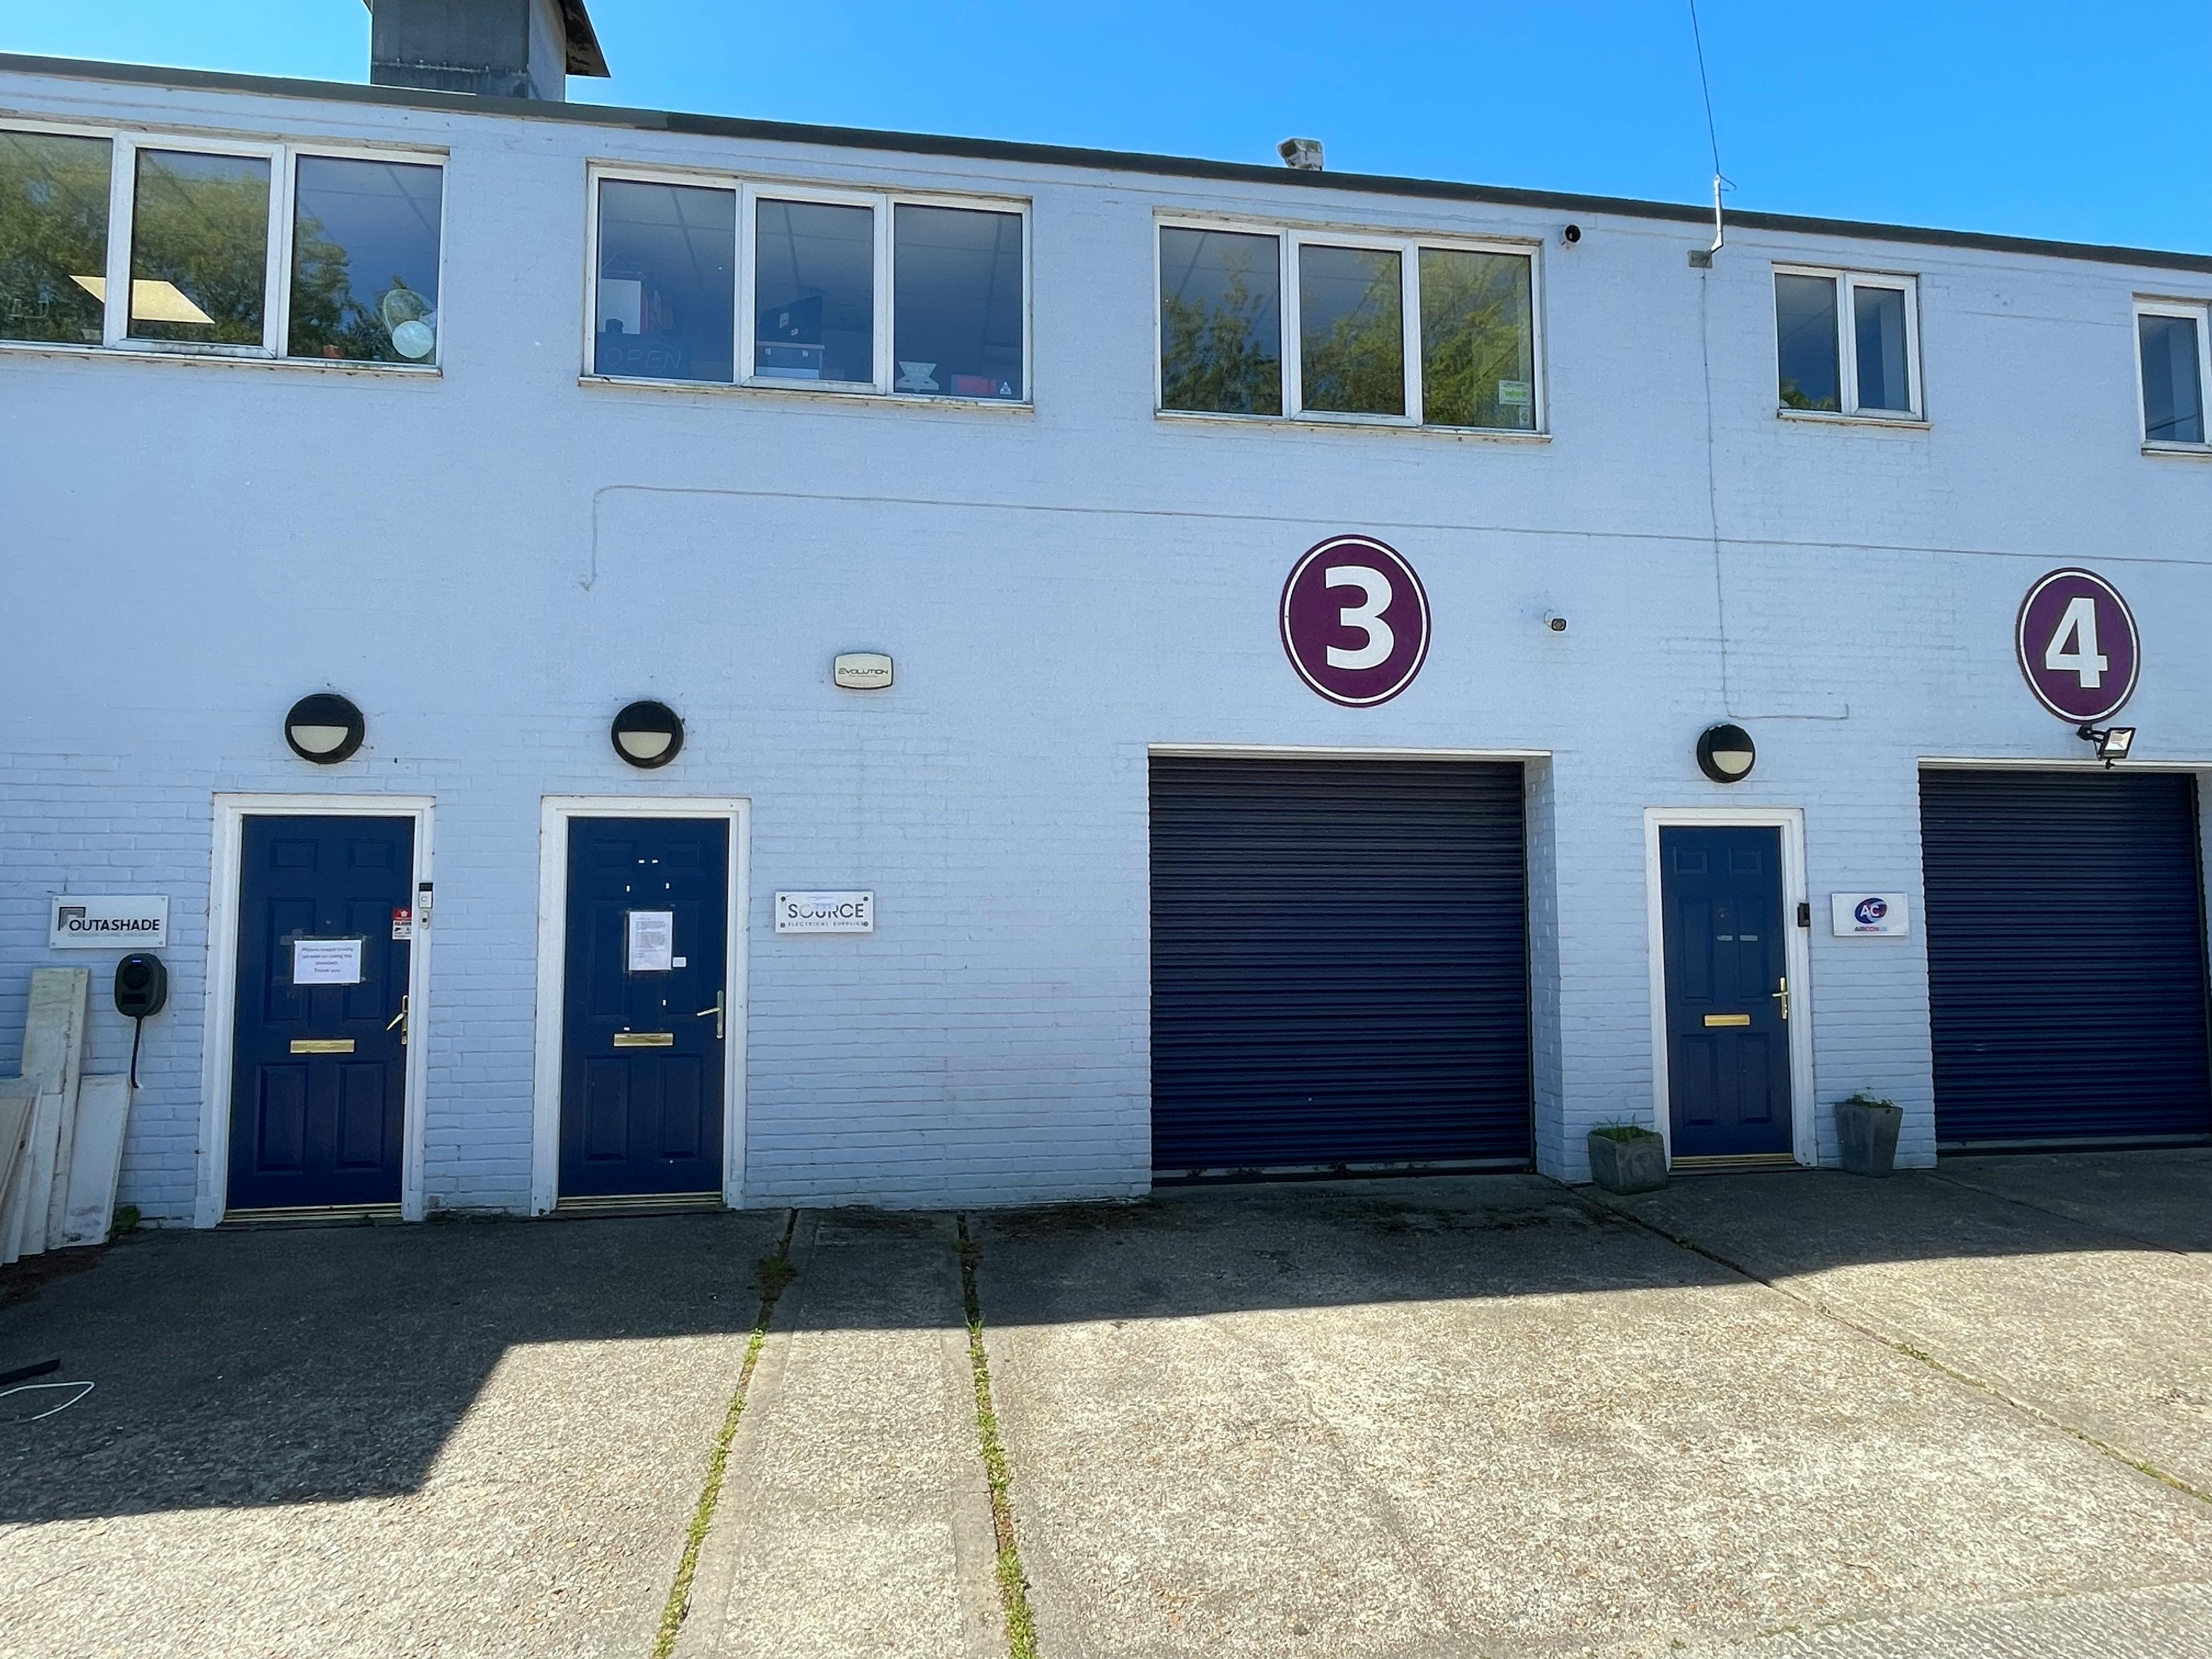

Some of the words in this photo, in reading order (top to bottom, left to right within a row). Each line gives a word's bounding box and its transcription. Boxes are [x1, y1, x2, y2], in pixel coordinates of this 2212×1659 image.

[605, 347, 681, 369] OPEN
[1325, 565, 1395, 670] 3
[2045, 597, 2108, 688] 4
[1860, 905, 1880, 917] AC
[69, 918, 160, 932] OUTASHADE
